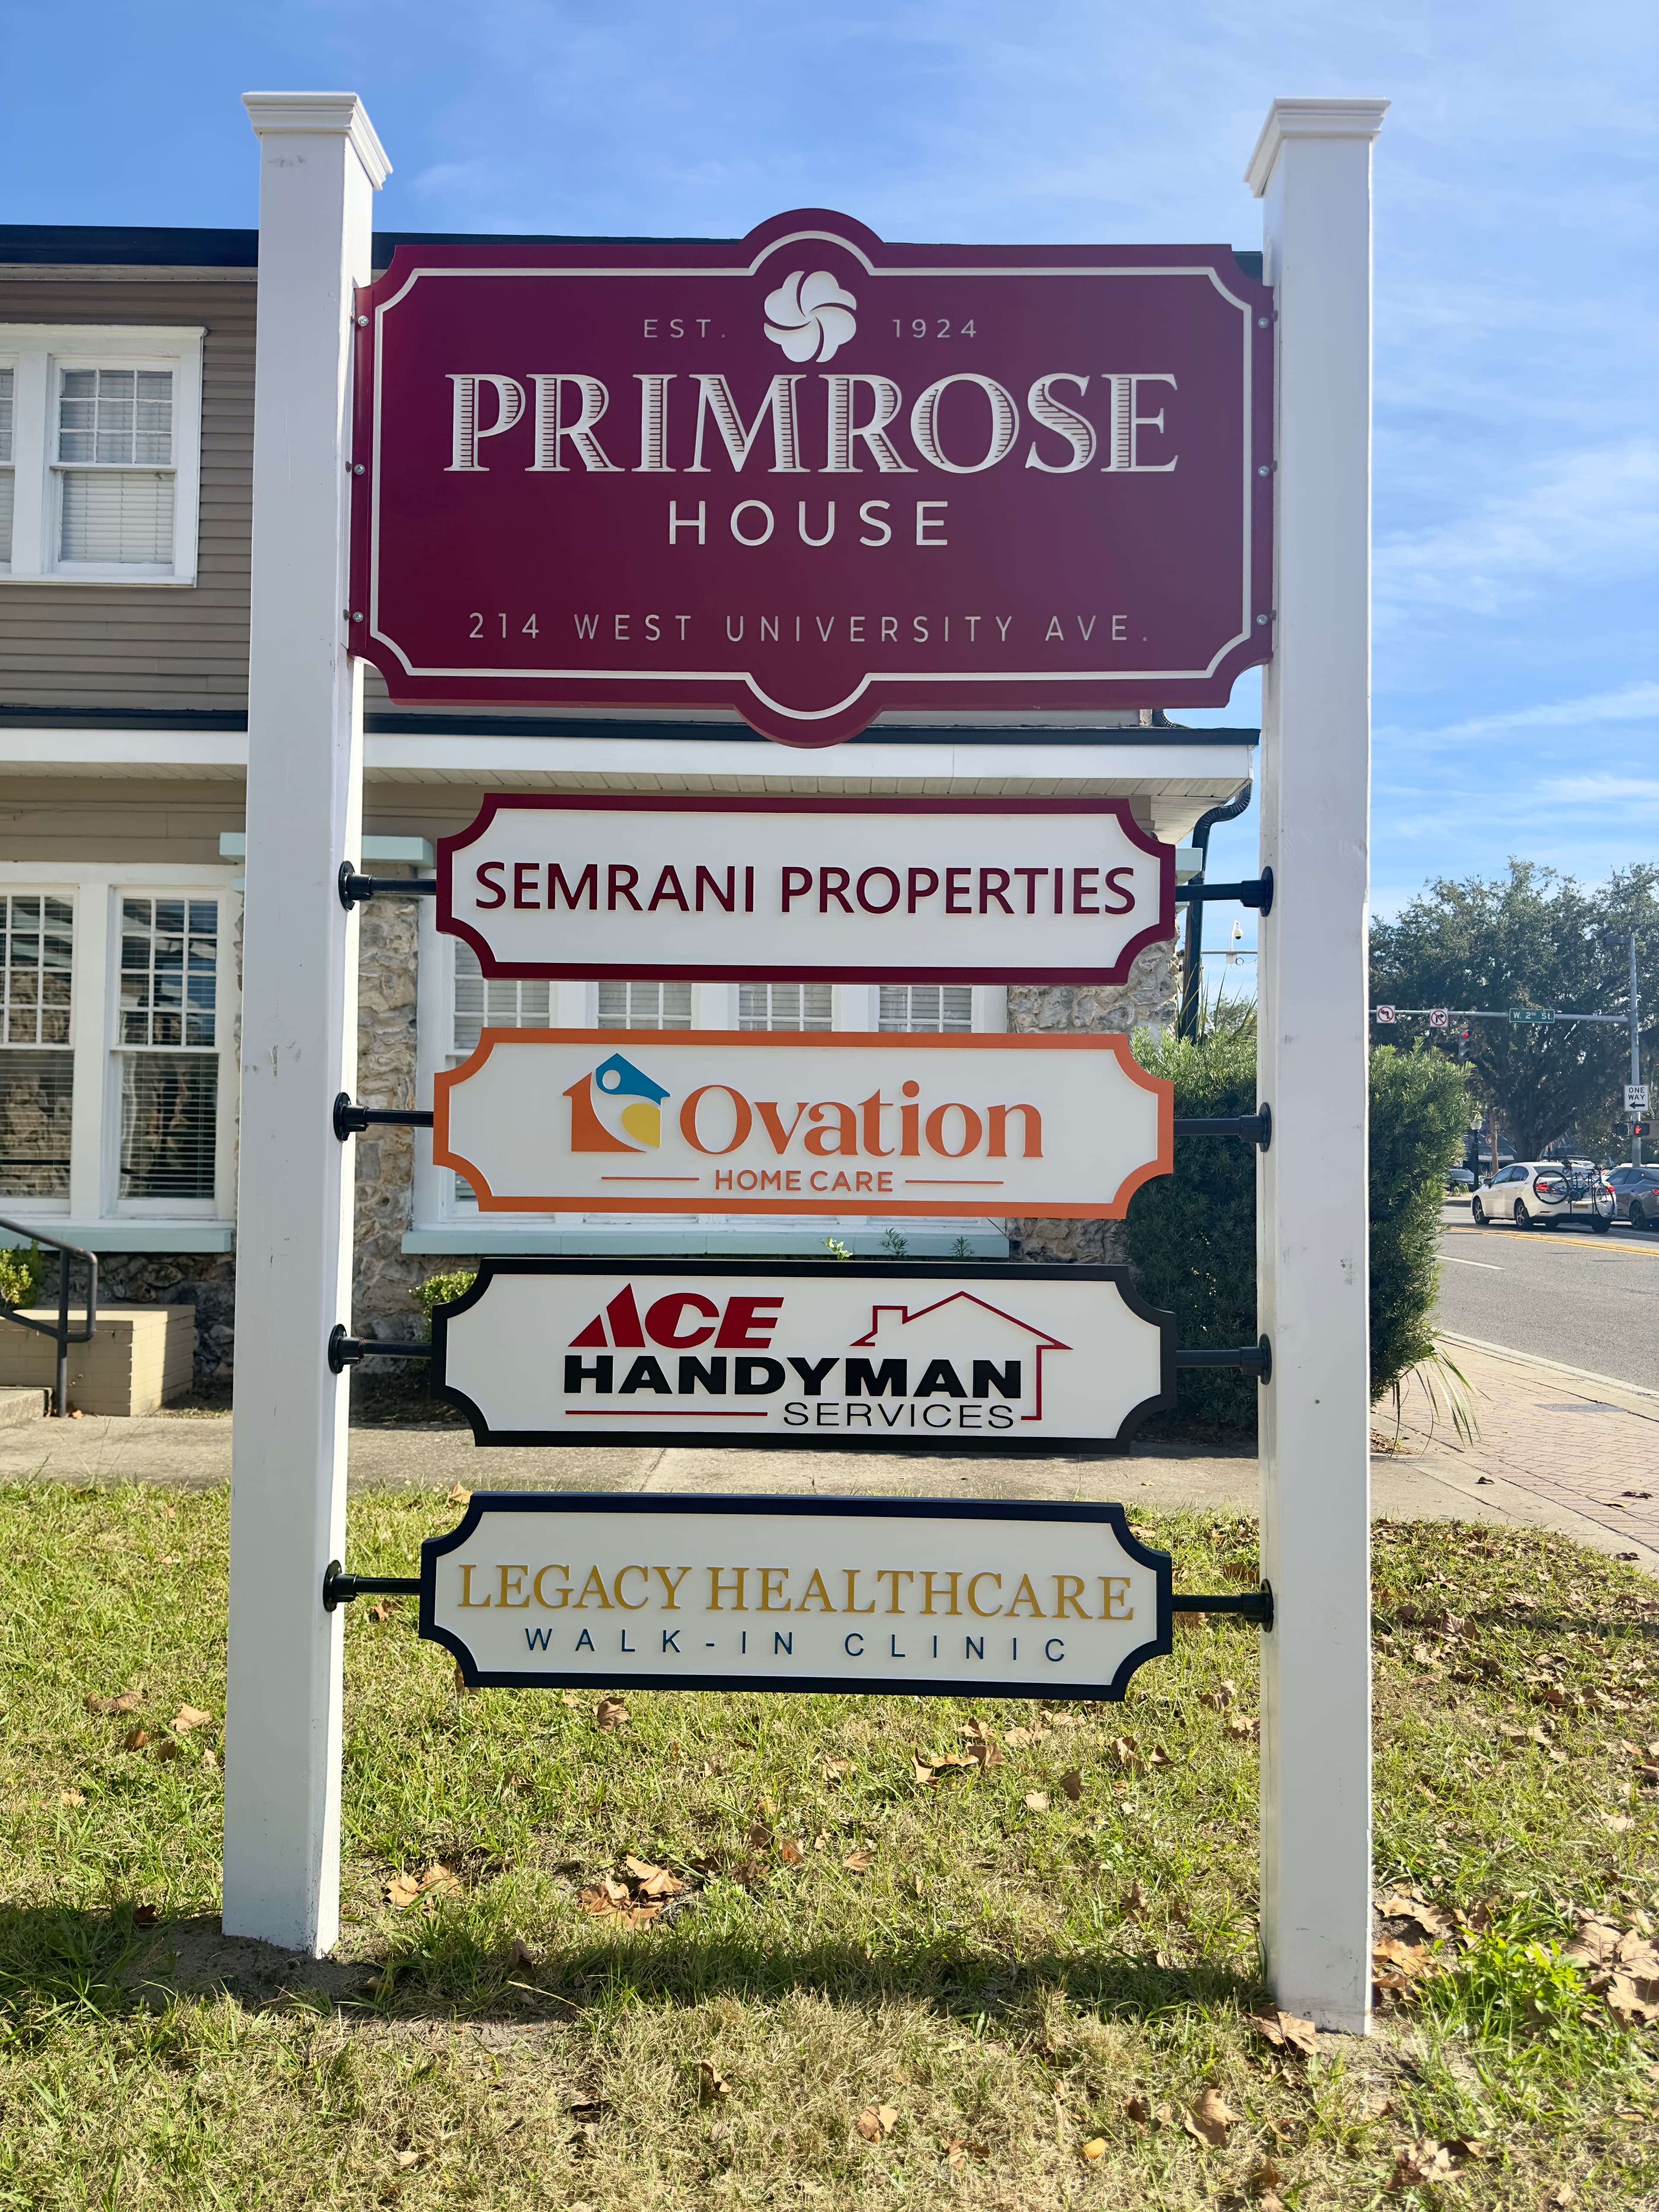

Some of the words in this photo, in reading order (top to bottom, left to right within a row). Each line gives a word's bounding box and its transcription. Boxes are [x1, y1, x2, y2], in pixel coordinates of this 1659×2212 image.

[644, 319, 727, 338] EST.
[893, 319, 976, 338] 1924
[444, 373, 1178, 474] PRIMROSE
[669, 500, 948, 547] HOUSE
[469, 612, 539, 639] 214
[574, 614, 691, 641] WEST
[727, 616, 1012, 642] UNIVERSITY
[1045, 615, 1147, 642] AVE.
[476, 861, 754, 912] SEMRANI
[782, 866, 1135, 915] PROPERTIES
[680, 1080, 1044, 1157] Ovation
[715, 1170, 801, 1191] HOME
[810, 1170, 893, 1192] CARE
[568, 1283, 785, 1349] ACE
[564, 1355, 1021, 1399] HANDYMAN
[783, 1402, 1014, 1429] SERVICES
[457, 1564, 692, 1610] LEGACY
[706, 1567, 1134, 1621] HEALTHCARE
[525, 1628, 792, 1655] WALK-IN
[845, 1633, 1065, 1662] CLINIC
